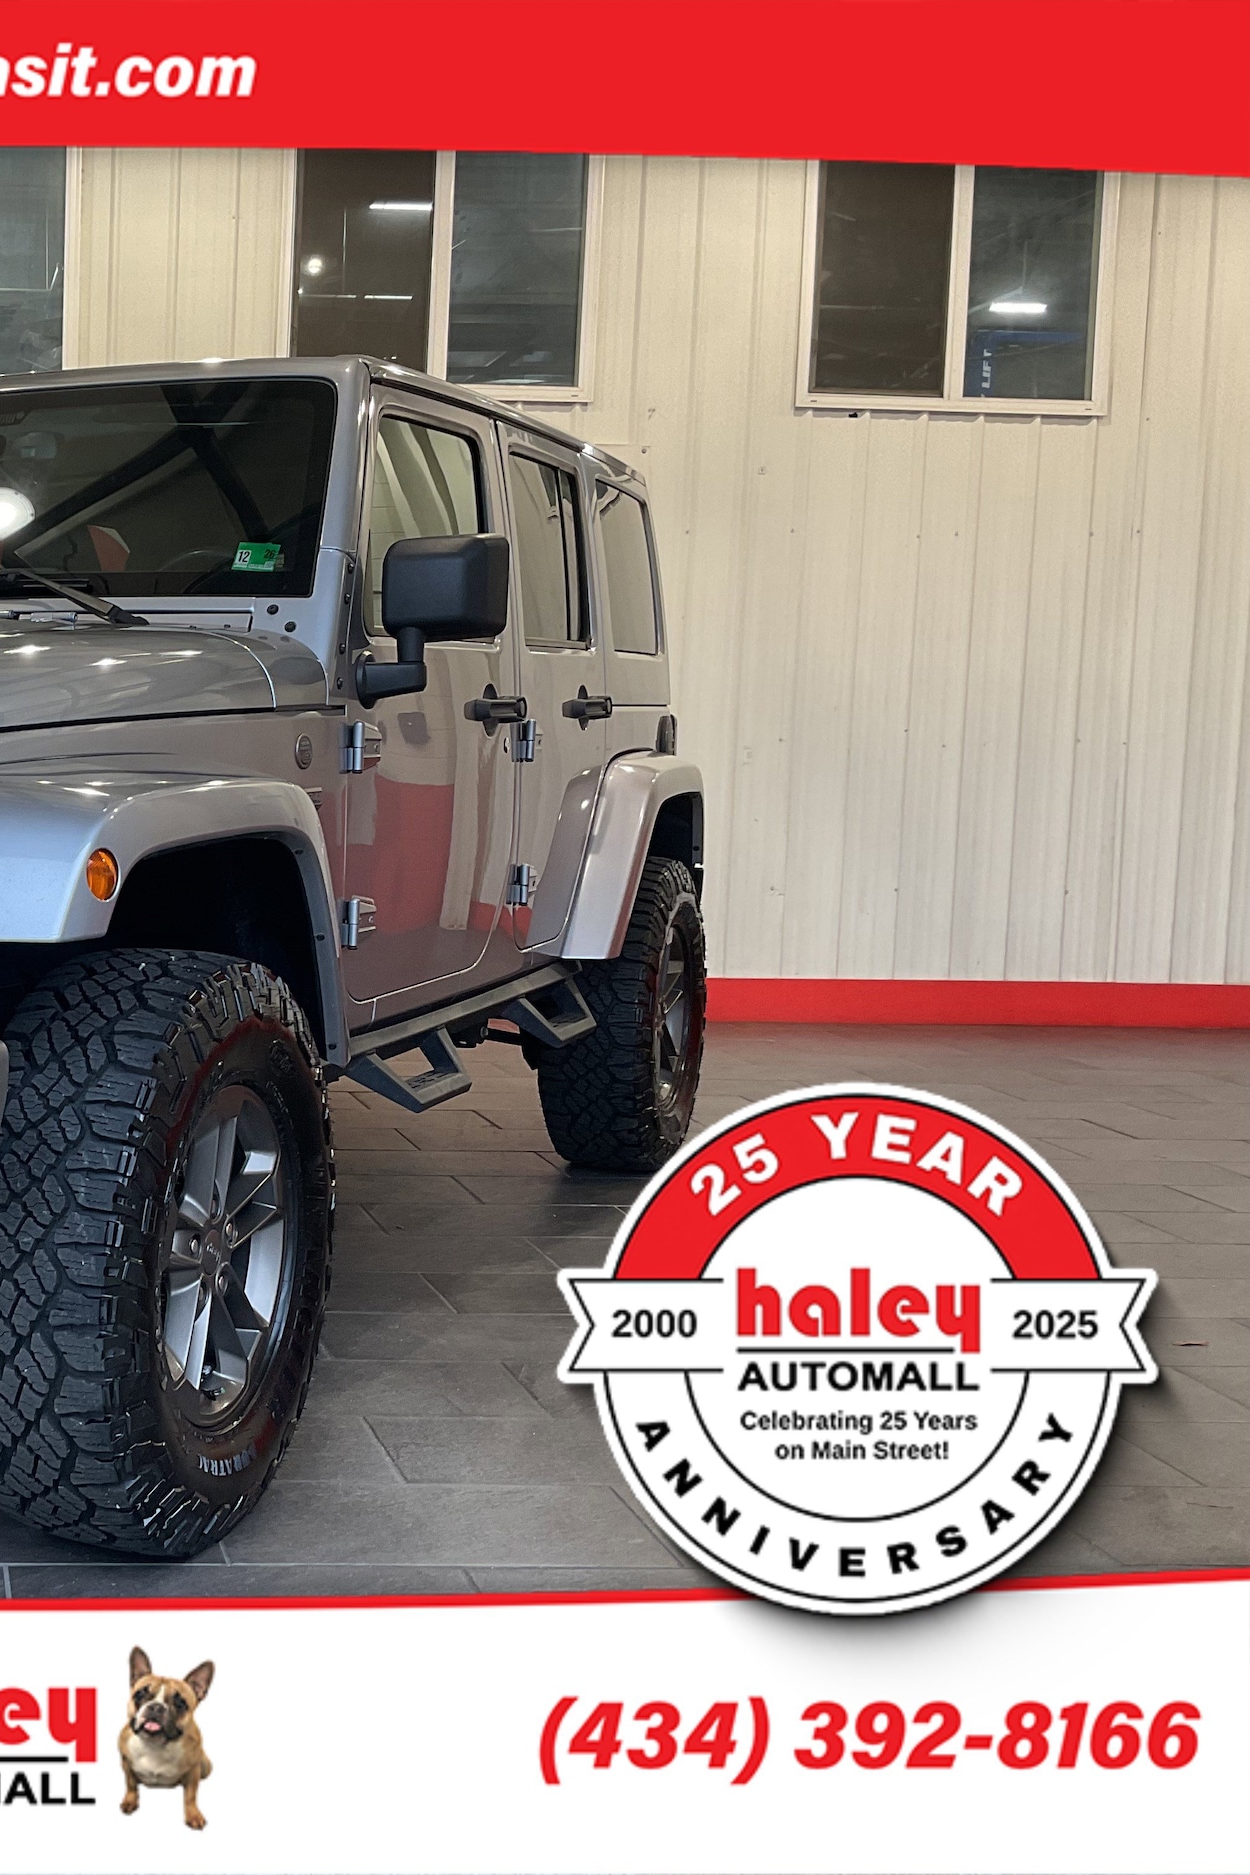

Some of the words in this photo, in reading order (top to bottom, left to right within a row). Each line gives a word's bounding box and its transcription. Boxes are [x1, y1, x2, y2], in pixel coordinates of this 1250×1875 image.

[981, 348, 992, 389] LIFT
[238, 550, 250, 563] 12
[263, 549, 276, 560] 26
